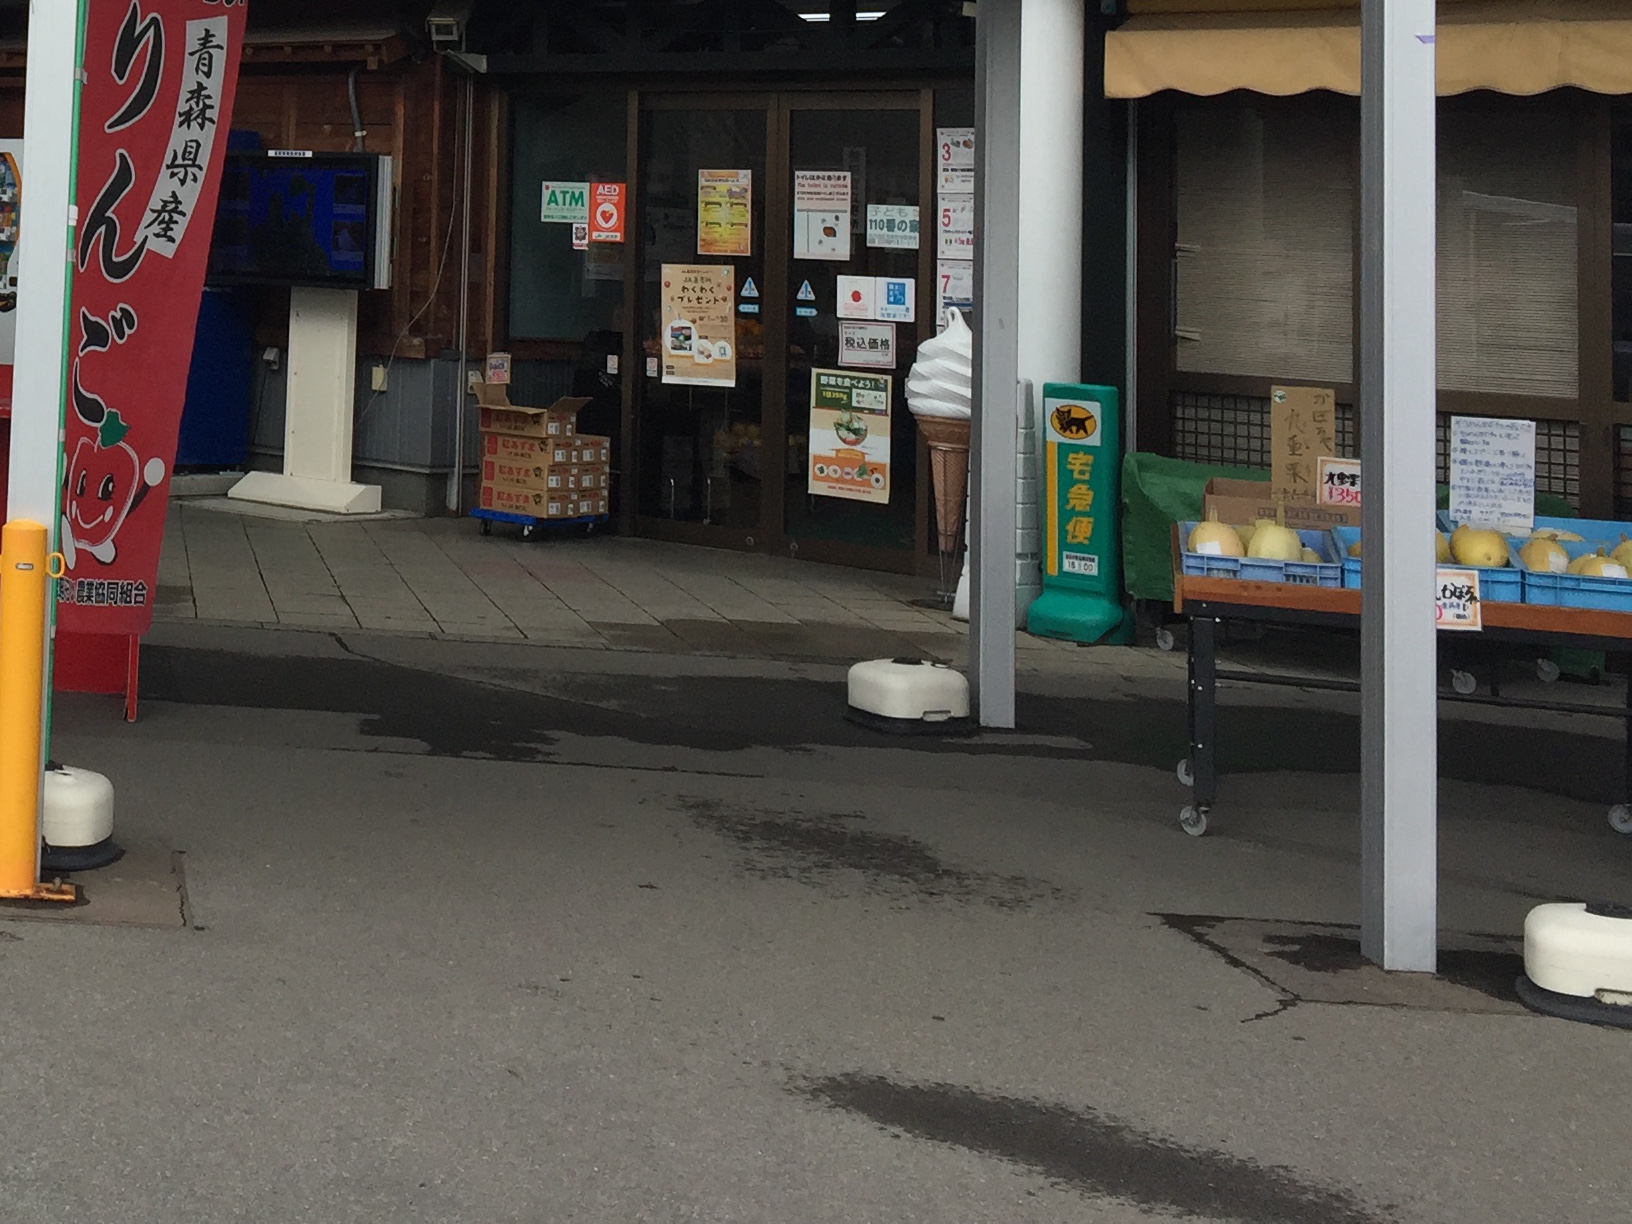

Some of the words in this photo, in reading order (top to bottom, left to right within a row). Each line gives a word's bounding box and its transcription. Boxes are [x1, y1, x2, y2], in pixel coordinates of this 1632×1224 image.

[143, 28, 225, 244] 青森県産
[547, 189, 585, 207] ATM
[597, 184, 619, 195] AED
[681, 285, 715, 294] わくわく
[845, 336, 890, 350] 税込価格
[1065, 449, 1095, 545] 宅急便
[1436, 582, 1480, 605] かぼちゃ
